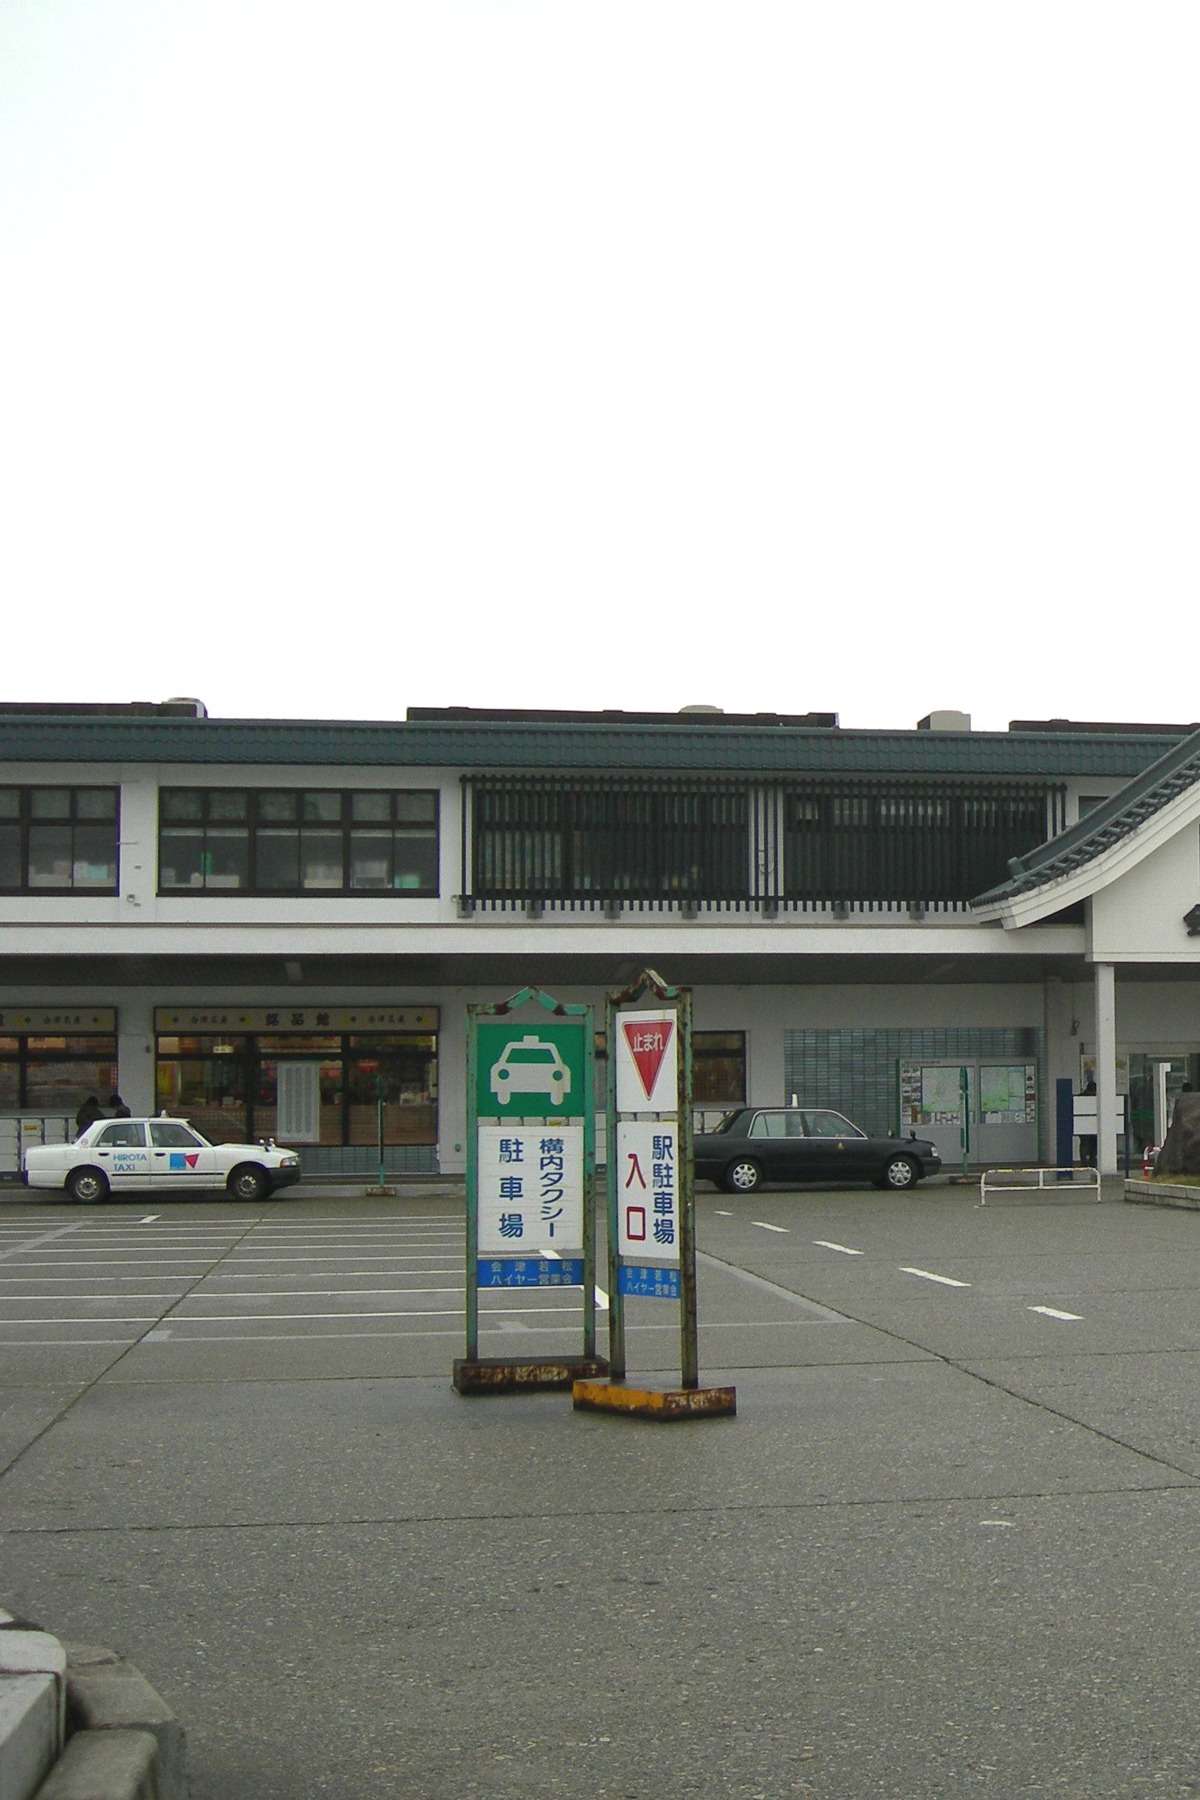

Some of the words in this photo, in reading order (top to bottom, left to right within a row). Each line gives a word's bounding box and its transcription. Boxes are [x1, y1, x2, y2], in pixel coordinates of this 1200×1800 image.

[632, 1032, 664, 1052] 止まれ
[112, 1153, 147, 1161] HIROTA
[113, 1163, 136, 1171] TAXI
[498, 1137, 524, 1238] 駐車場
[539, 1137, 564, 1238] 構内タクシー
[652, 1135, 675, 1245] 駅駐車場
[625, 1153, 647, 1241] 入口
[490, 1260, 573, 1273] 会津若松
[626, 1267, 677, 1282] 会津若松
[490, 1273, 573, 1286] ハイヤー営業会
